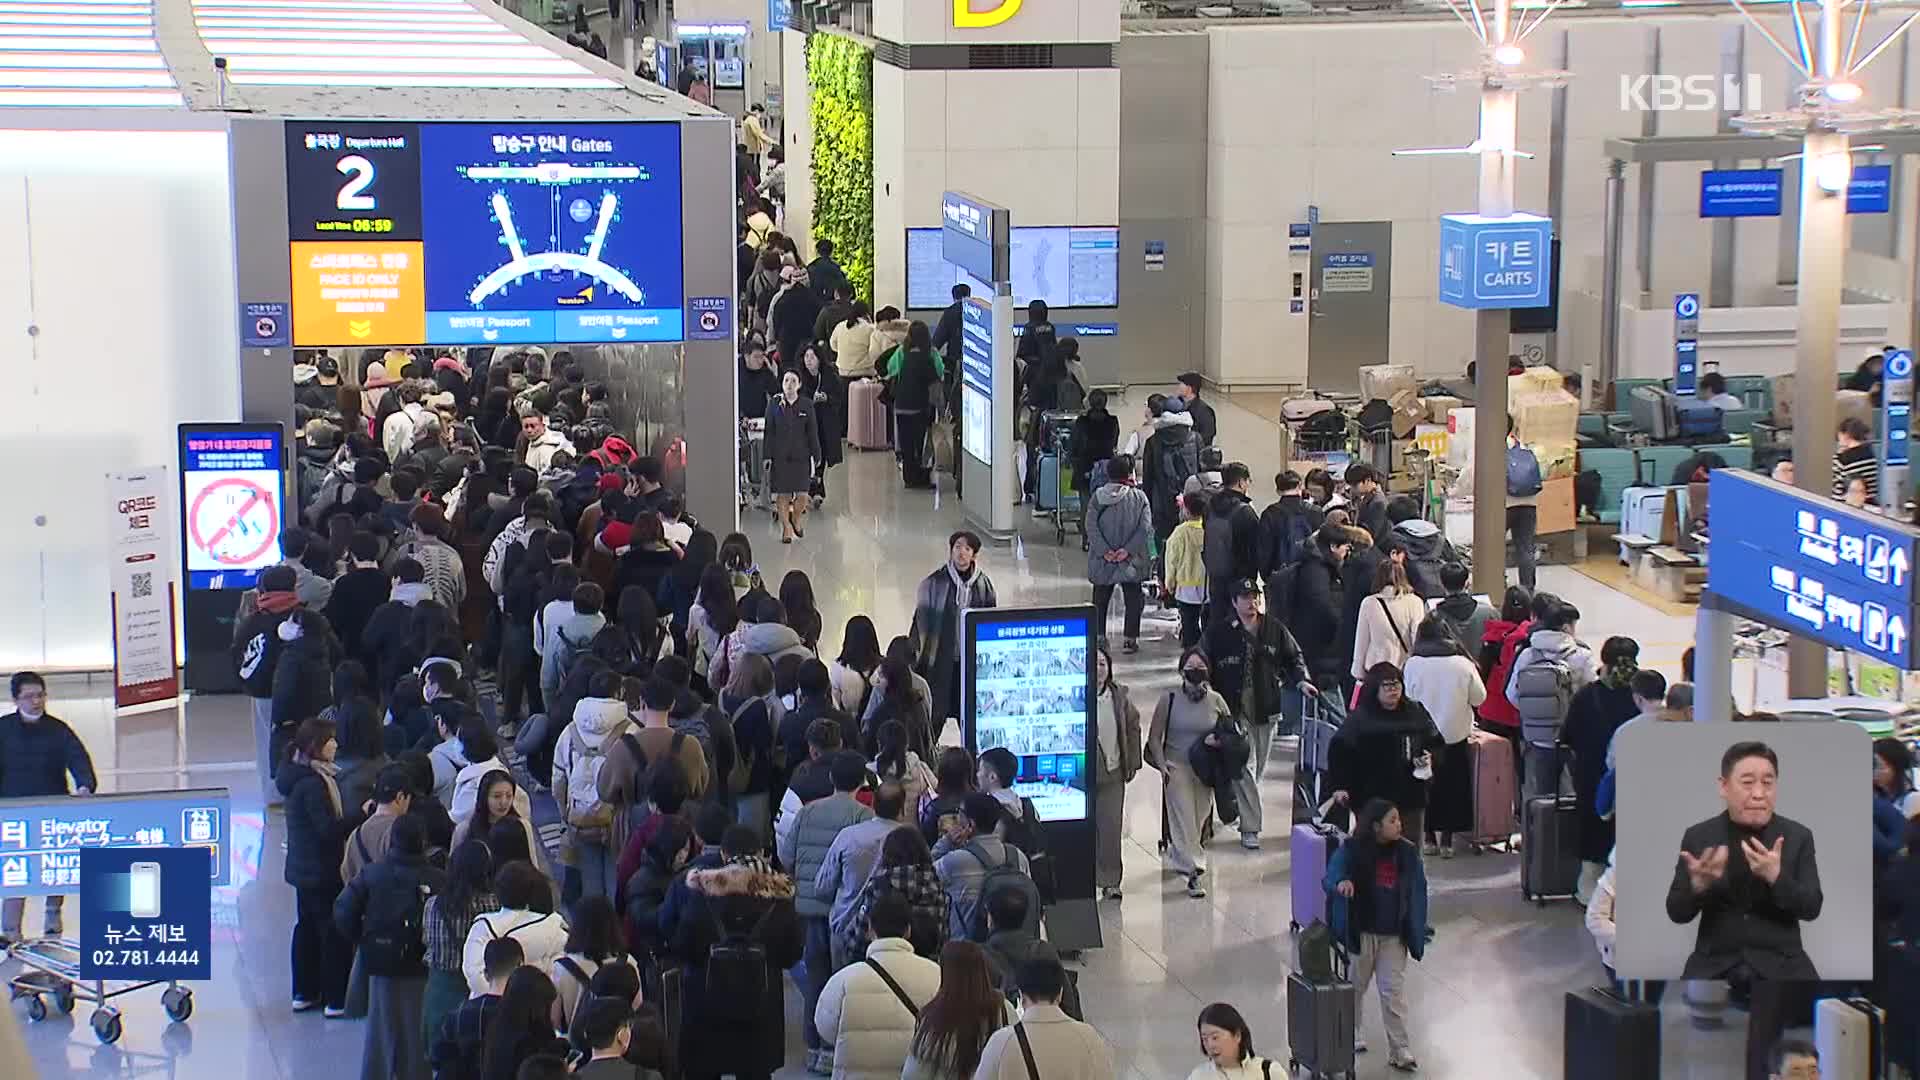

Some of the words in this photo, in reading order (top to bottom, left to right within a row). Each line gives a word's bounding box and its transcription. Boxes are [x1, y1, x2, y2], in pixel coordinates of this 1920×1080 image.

[492, 135, 536, 153] 탑승구
[538, 135, 567, 153] 안내
[571, 138, 613, 153] Gates
[336, 154, 375, 210] 2
[1486, 241, 1532, 268] 카트
[1484, 272, 1531, 286] CARTS
[488, 317, 530, 328] Passport
[617, 315, 658, 326] Passport
[2, 820, 27, 848] 터
[41, 818, 110, 835] Elevator
[3, 857, 28, 887] 실
